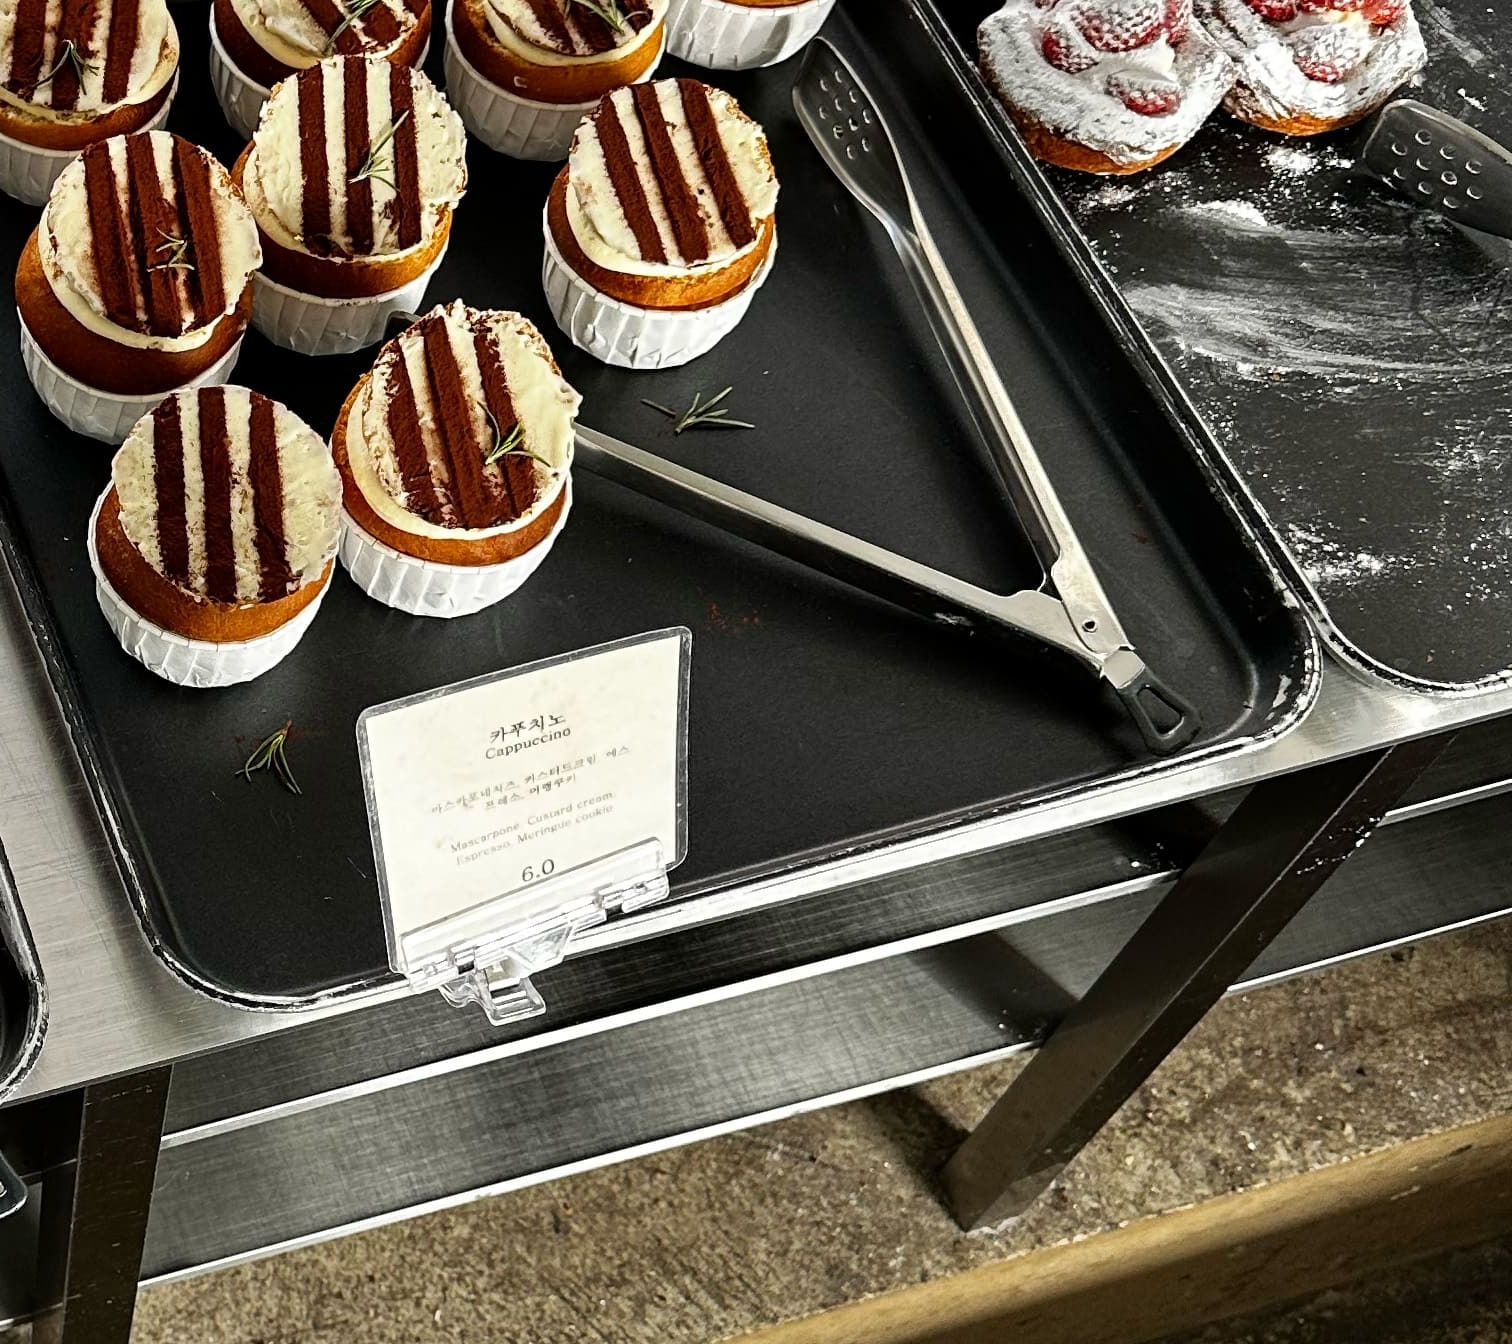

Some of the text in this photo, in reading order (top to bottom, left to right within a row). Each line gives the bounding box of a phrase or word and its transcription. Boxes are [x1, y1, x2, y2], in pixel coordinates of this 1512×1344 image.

[489, 714, 566, 743] 카푸치노
[485, 727, 571, 759] Cappuccino
[606, 745, 631, 758] 에스
[521, 859, 555, 882] 6.0
